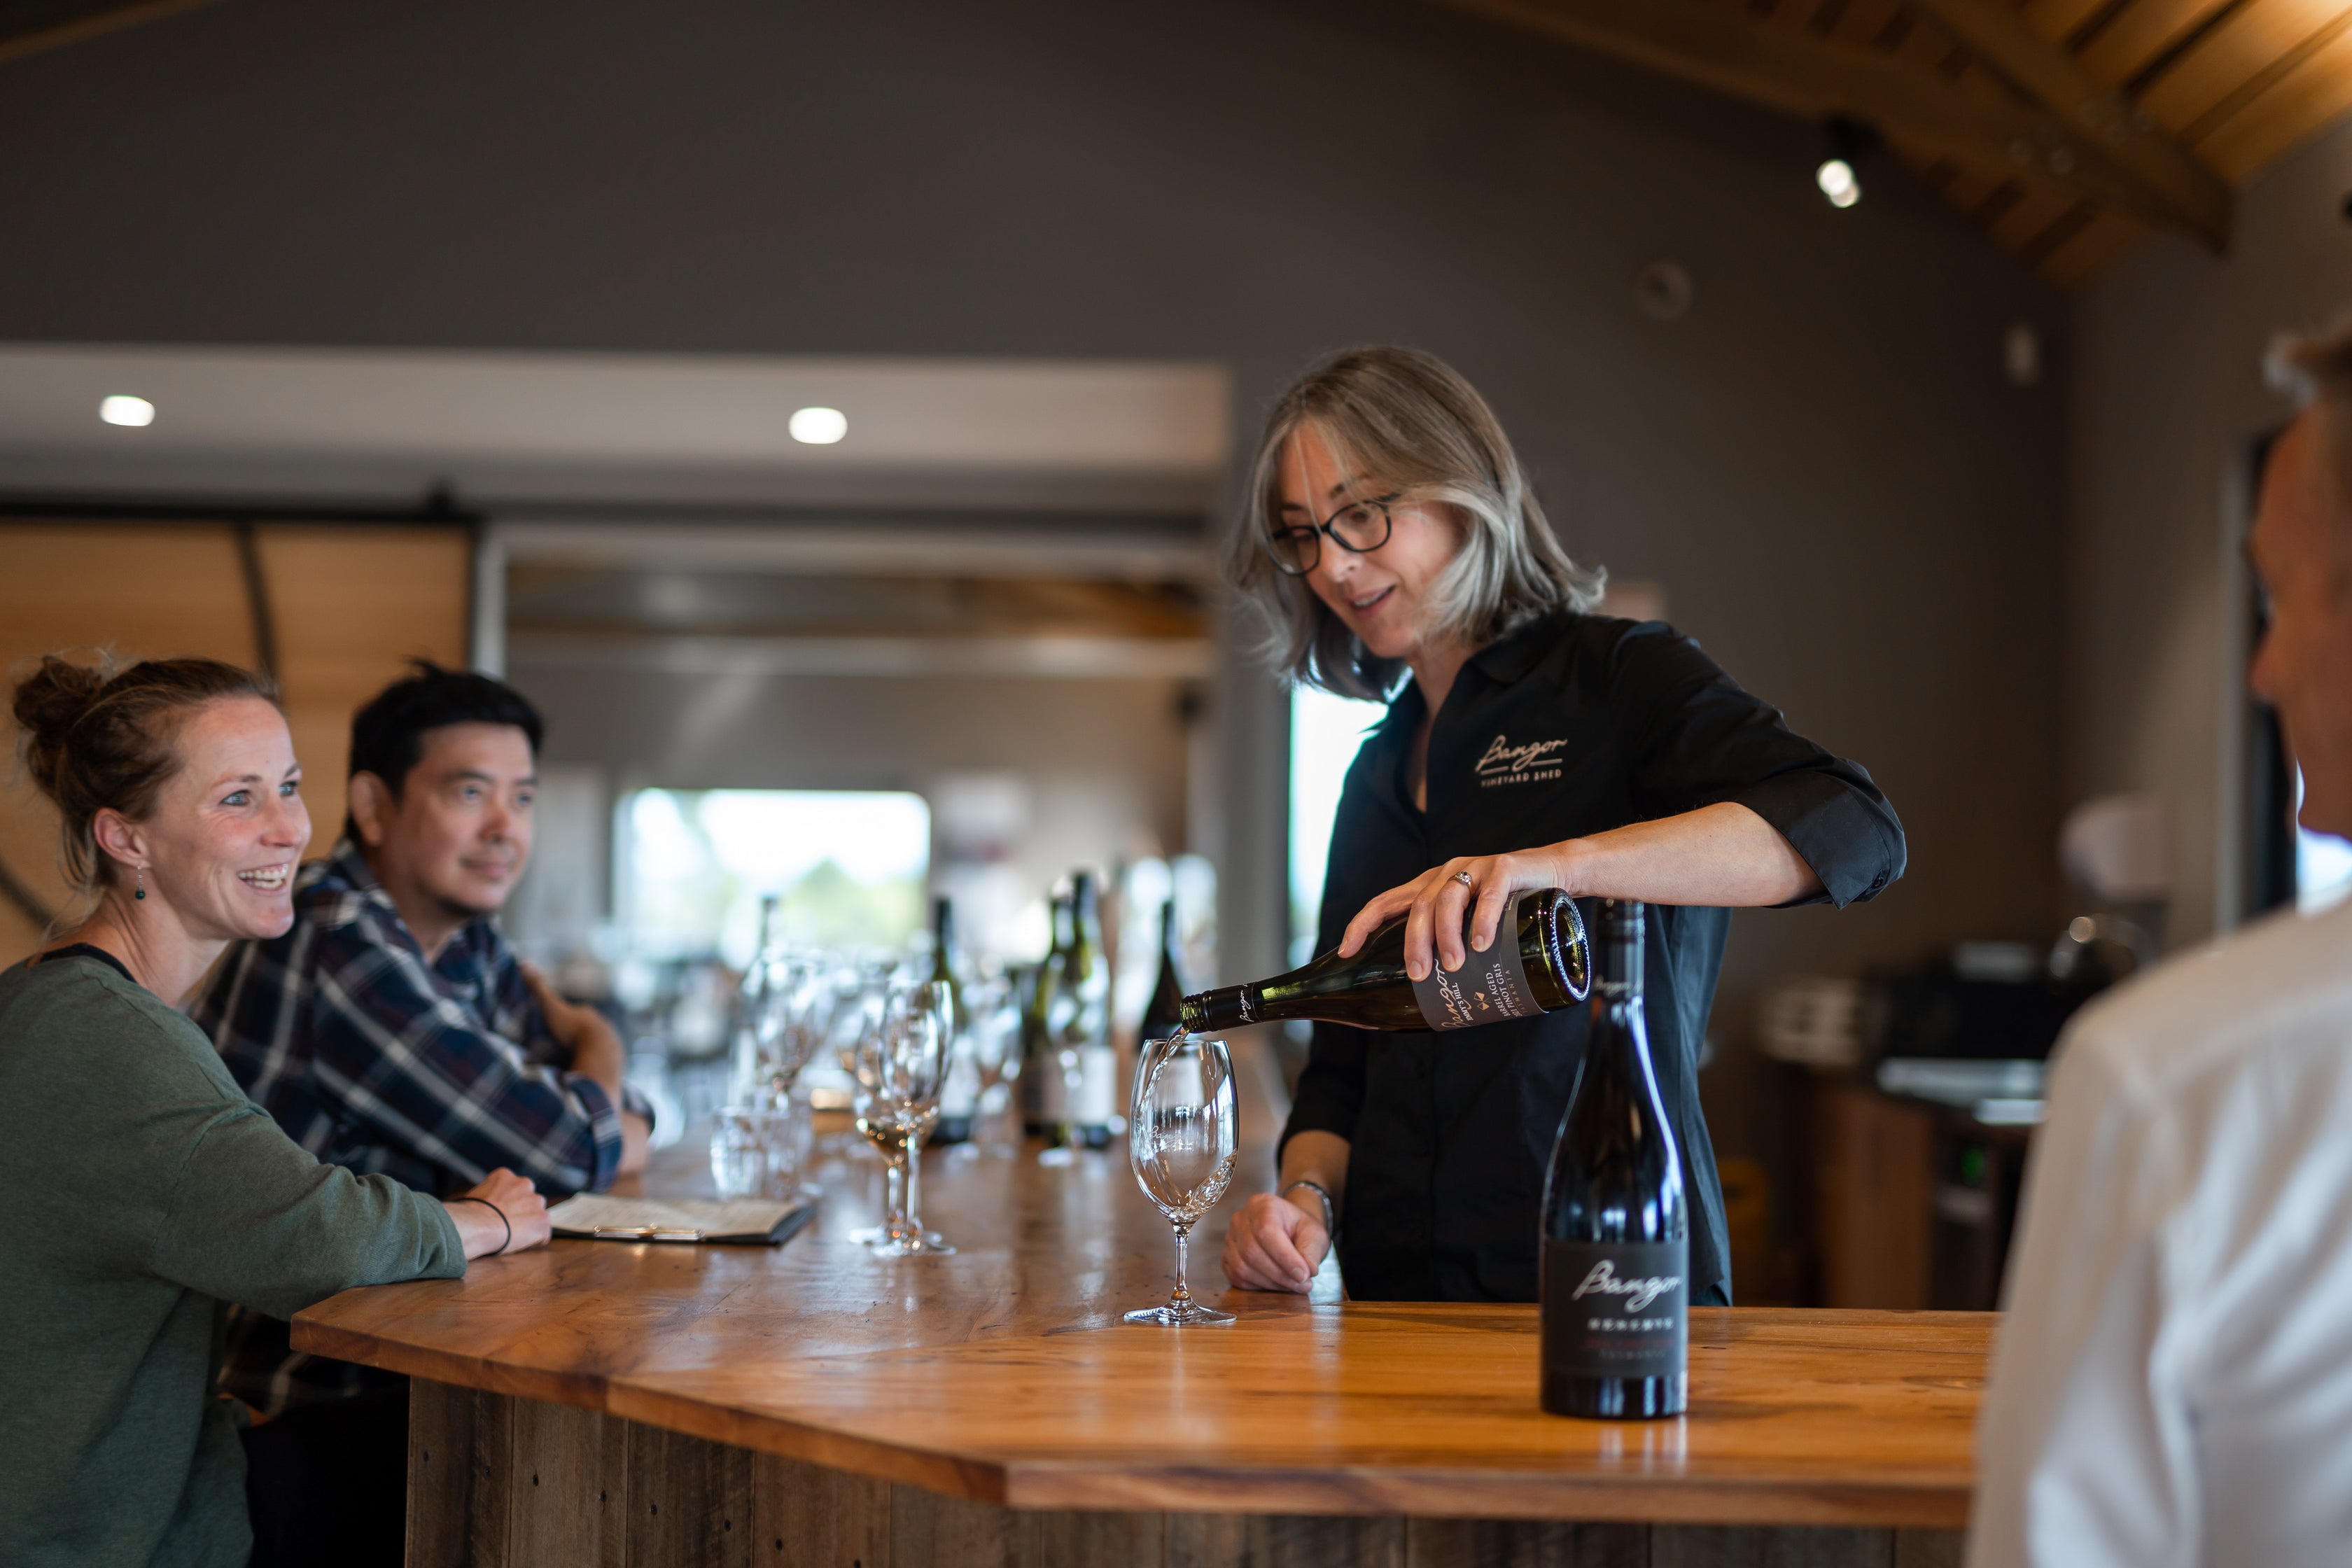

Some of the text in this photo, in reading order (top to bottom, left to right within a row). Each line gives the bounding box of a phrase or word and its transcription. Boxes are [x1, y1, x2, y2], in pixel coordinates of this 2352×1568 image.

[1475, 734, 1569, 772] Bangor
[1480, 769, 1562, 788] VINEYARD SHED
[1492, 963, 1504, 984] GRIS
[1434, 958, 1471, 1028] Bangor
[1452, 982, 1462, 999] HILL
[1485, 972, 1511, 1017] BARREL AGED
[1499, 987, 1515, 1008] PINOT
[1240, 990, 1254, 1022] Bangor
